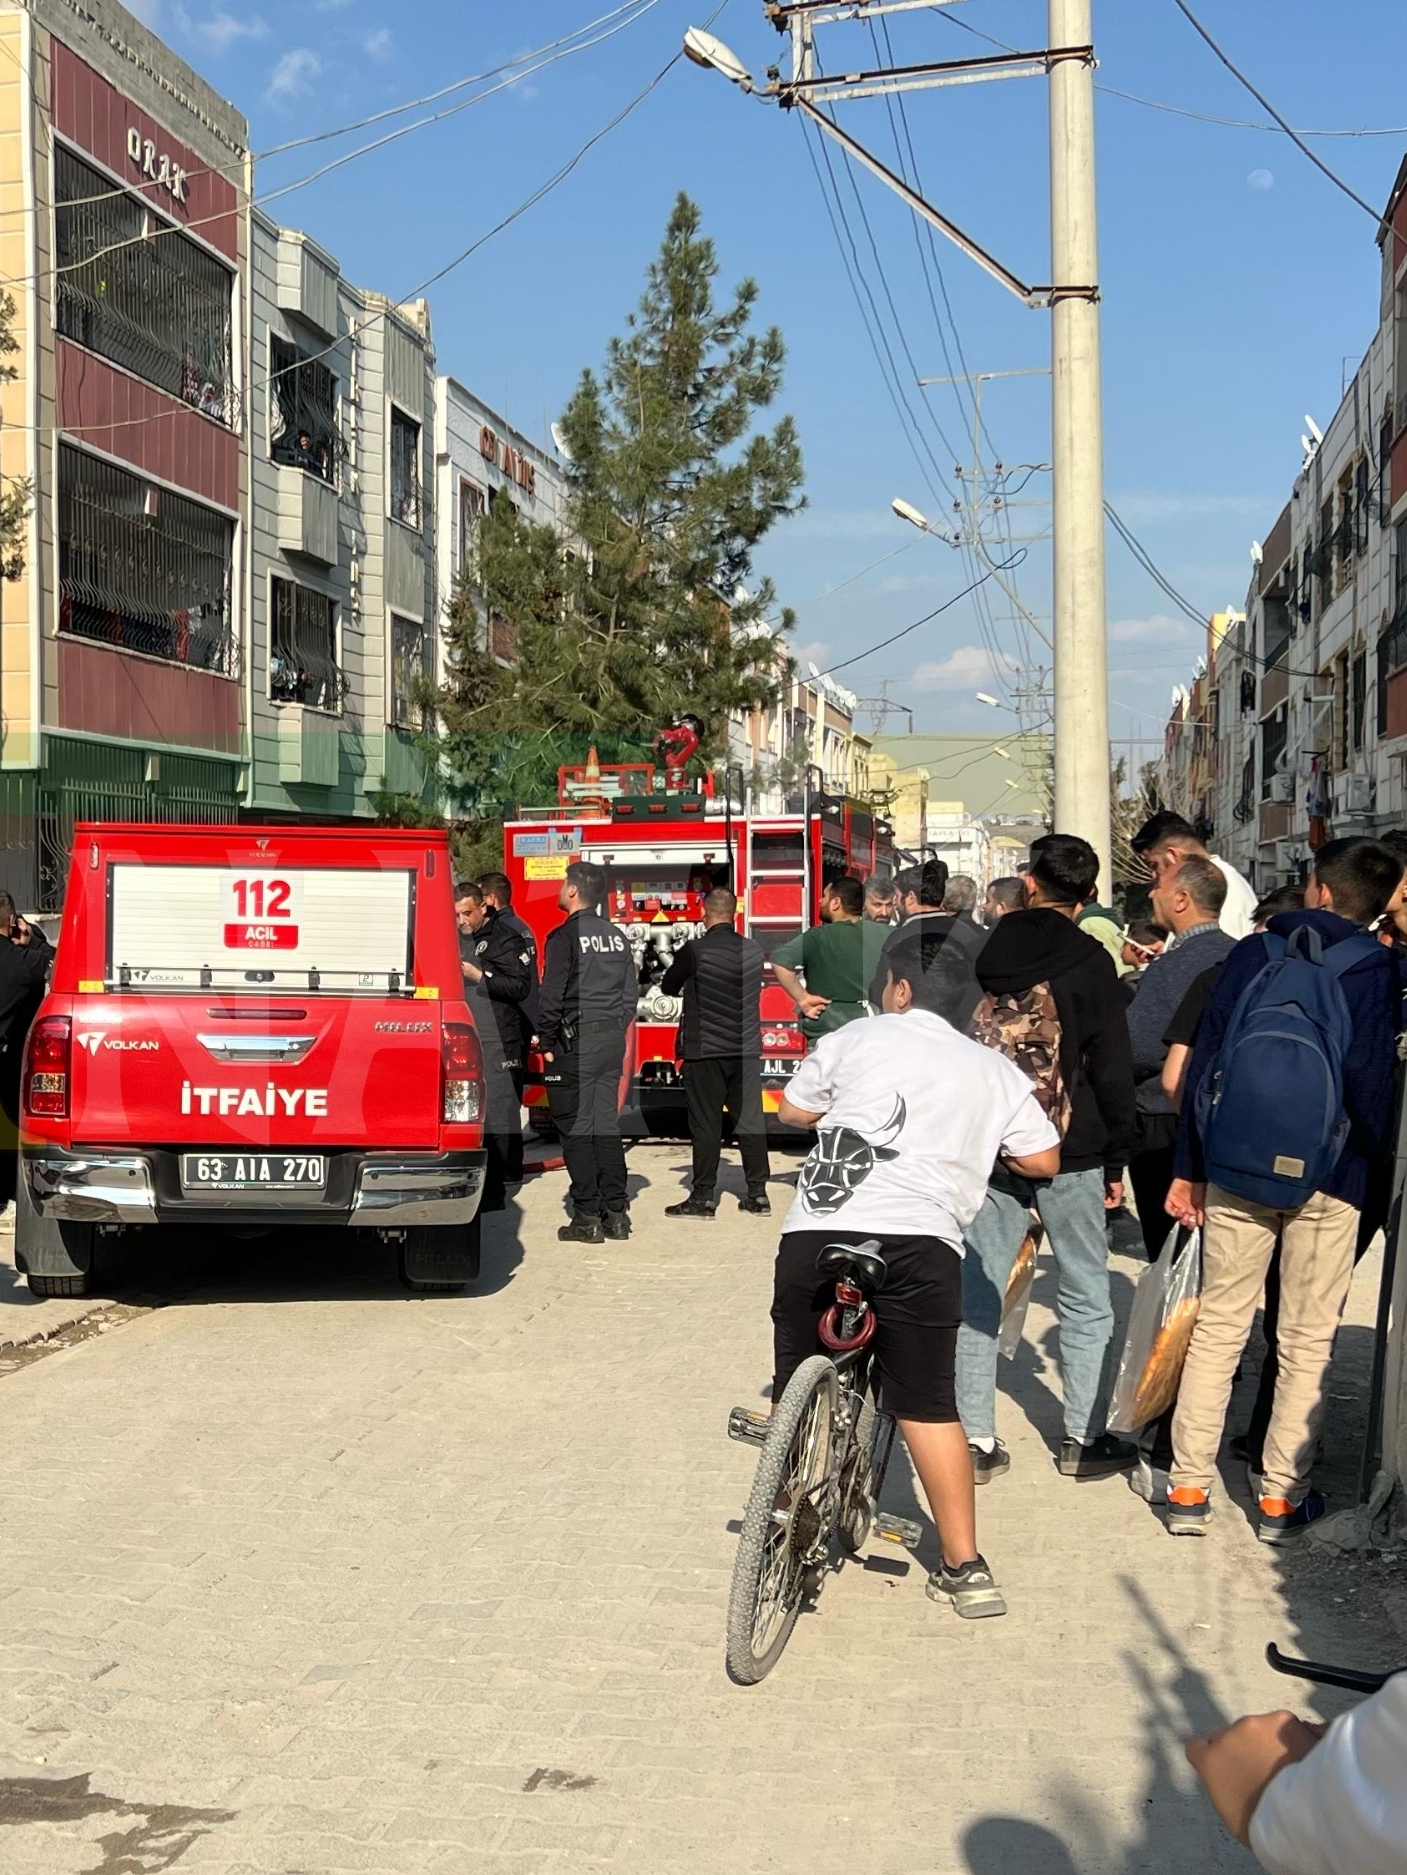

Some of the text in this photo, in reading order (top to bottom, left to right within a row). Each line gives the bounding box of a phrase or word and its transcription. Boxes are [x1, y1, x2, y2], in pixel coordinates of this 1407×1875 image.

[233, 879, 291, 918] 112
[149, 974, 184, 982] VOLKAN
[103, 1039, 159, 1051] VOLKAN
[763, 1059, 803, 1074] AJL 2
[181, 1080, 328, 1117] İTFAİYE
[197, 1158, 223, 1181] 63
[283, 1158, 320, 1181] 270
